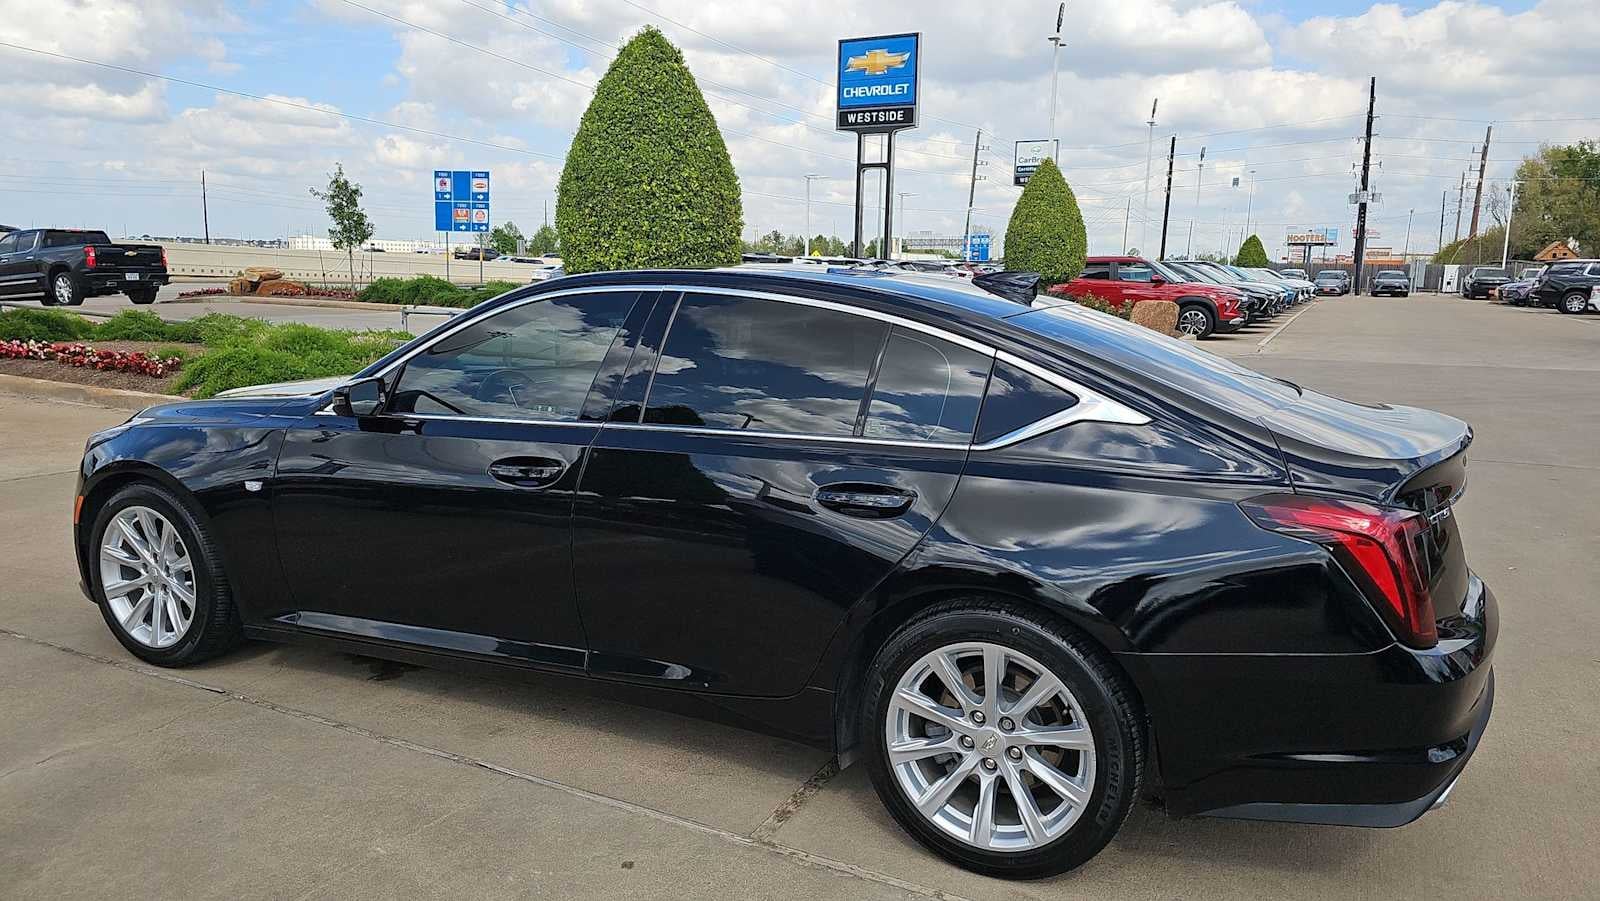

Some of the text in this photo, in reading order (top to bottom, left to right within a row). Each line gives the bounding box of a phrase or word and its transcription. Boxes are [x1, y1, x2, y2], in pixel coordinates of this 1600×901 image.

[843, 83, 910, 98] CHEVROLET
[847, 110, 905, 123] WESTSIDE
[1287, 234, 1325, 242] HOOTERS
[1099, 741, 1120, 822] MICHELIN
